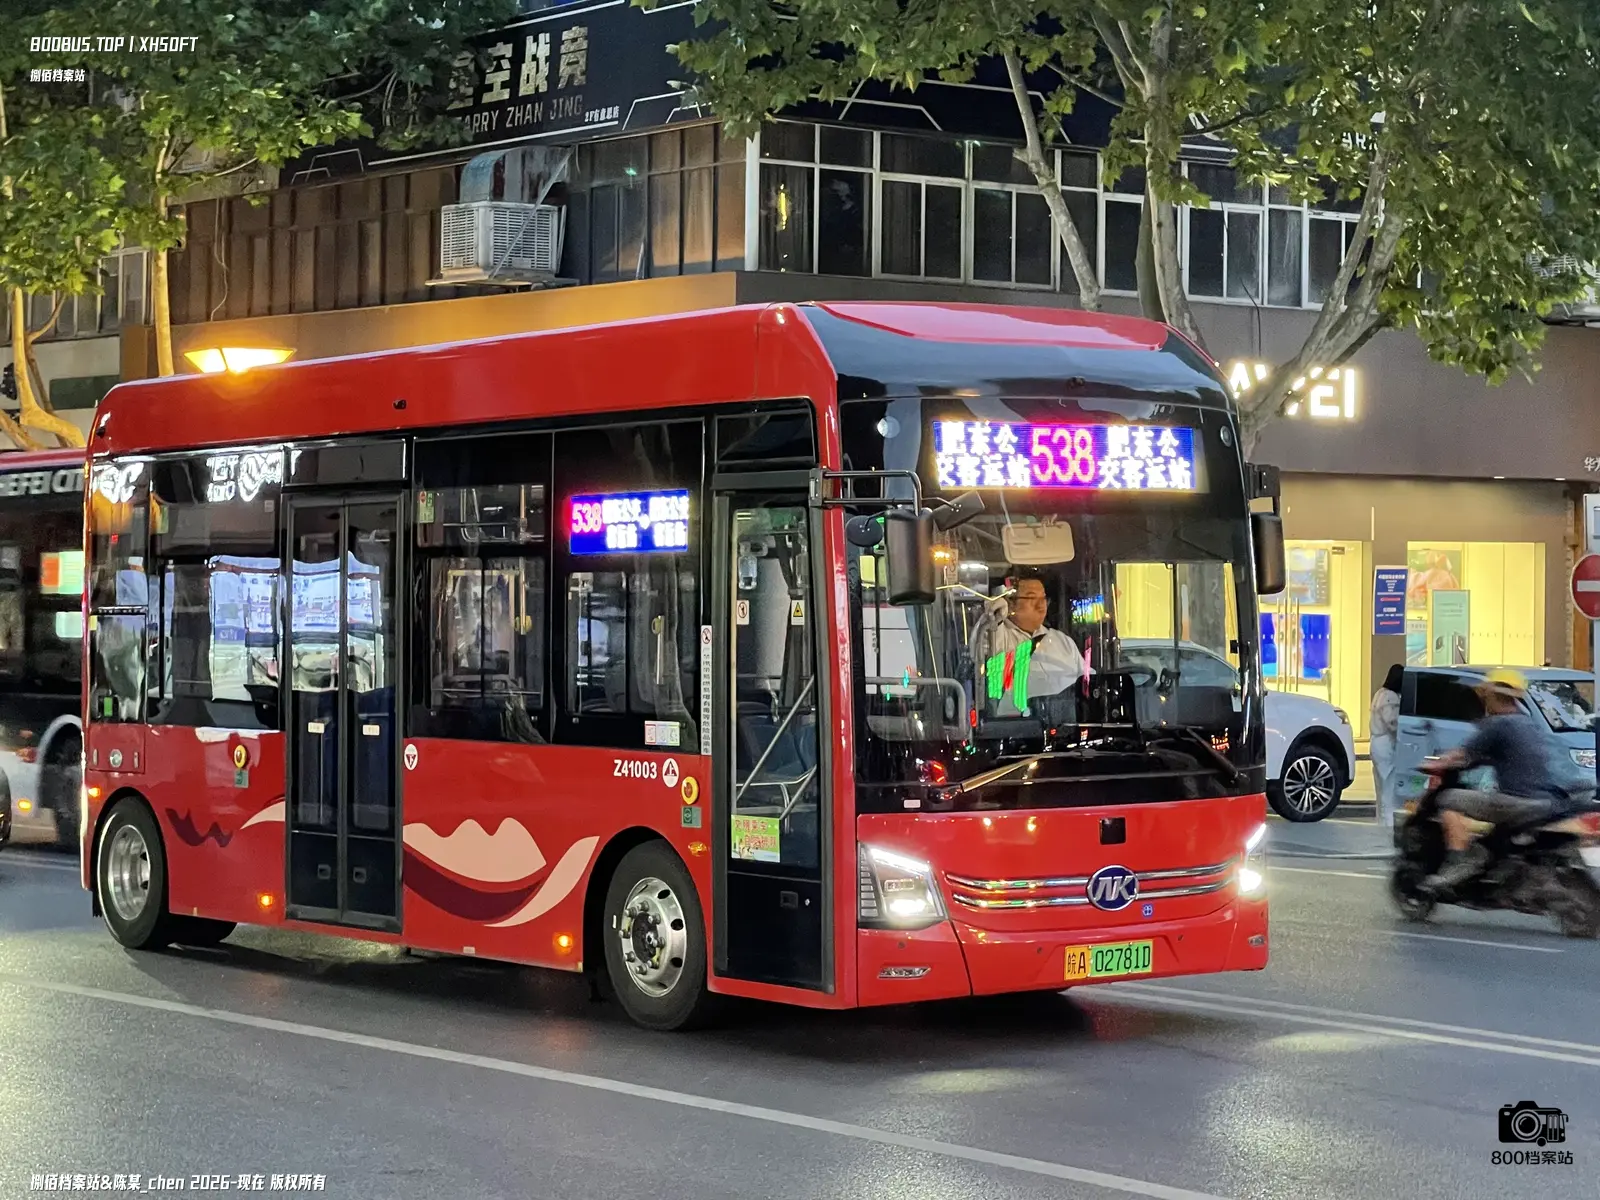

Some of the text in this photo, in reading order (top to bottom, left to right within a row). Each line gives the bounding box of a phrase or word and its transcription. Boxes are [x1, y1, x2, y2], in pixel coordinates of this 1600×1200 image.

[506, 102, 543, 128] ZHAN
[550, 94, 583, 120] JING
[1031, 427, 1094, 483] 538
[571, 502, 602, 533] 538
[613, 759, 658, 779] Z41003
[1095, 945, 1152, 972] 02781D
